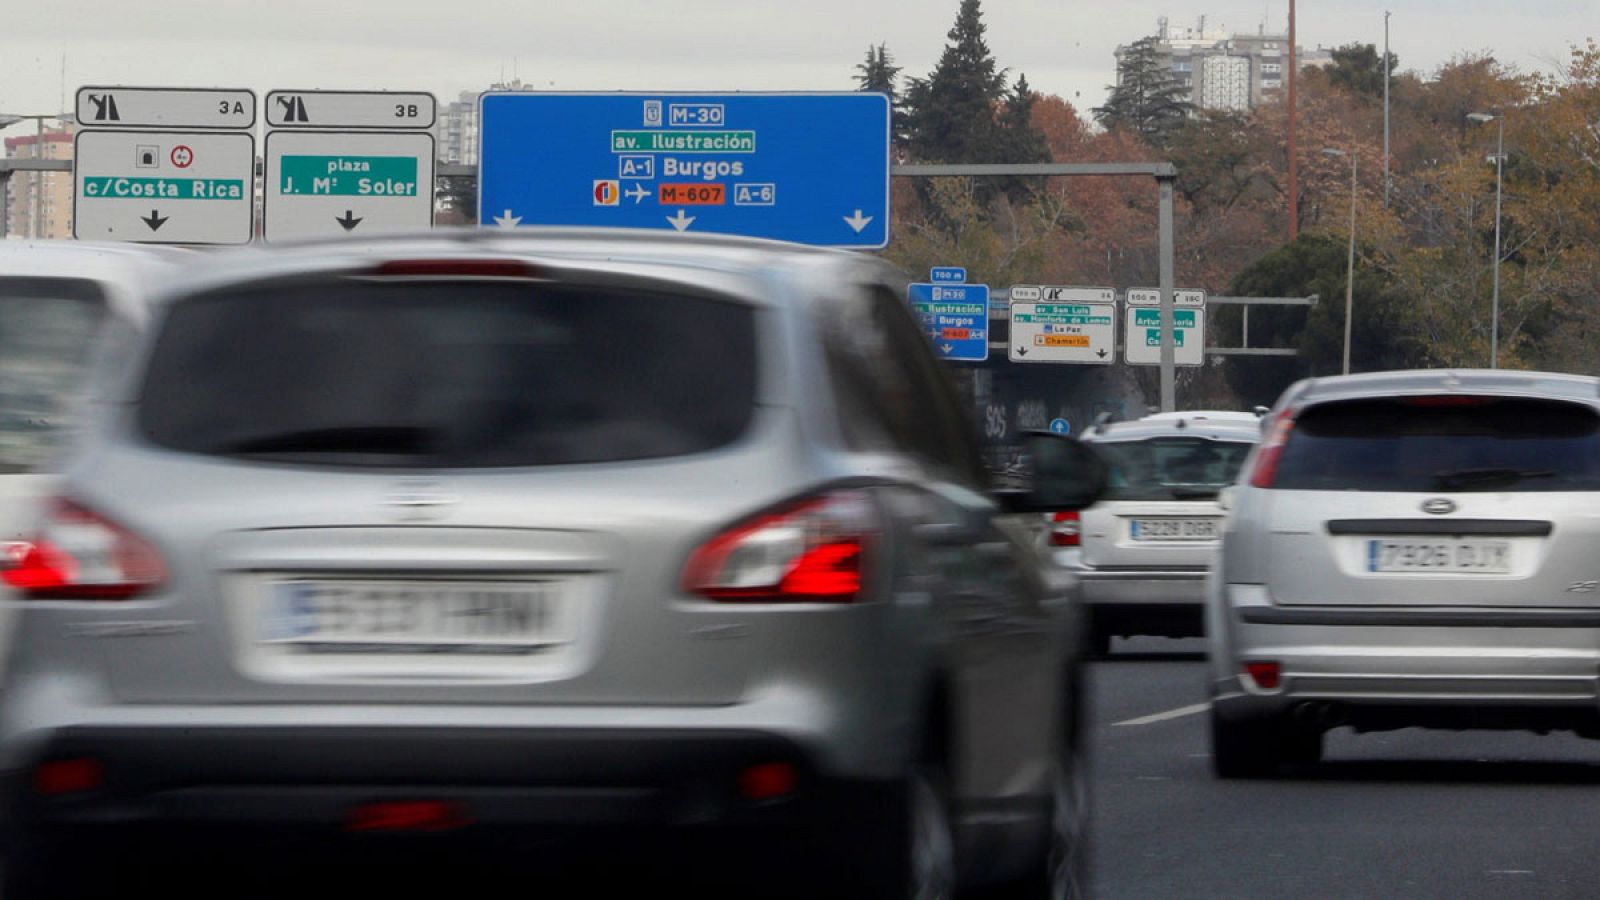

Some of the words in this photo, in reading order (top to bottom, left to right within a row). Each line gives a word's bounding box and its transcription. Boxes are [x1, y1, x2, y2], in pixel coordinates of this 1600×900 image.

[394, 104, 418, 118] 3B
[672, 108, 722, 122] M-30
[615, 136, 640, 149] av.
[652, 134, 751, 149] Ilustración
[327, 159, 370, 174] plaza
[622, 159, 652, 174] A-1
[663, 157, 743, 180] Burgos
[86, 178, 179, 197] c/Costa
[192, 180, 240, 198] Rica
[282, 176, 299, 193] J.
[358, 176, 415, 195] Soler
[662, 187, 722, 201] M-607
[738, 187, 773, 201] A-6
[940, 315, 973, 327] Burgos
